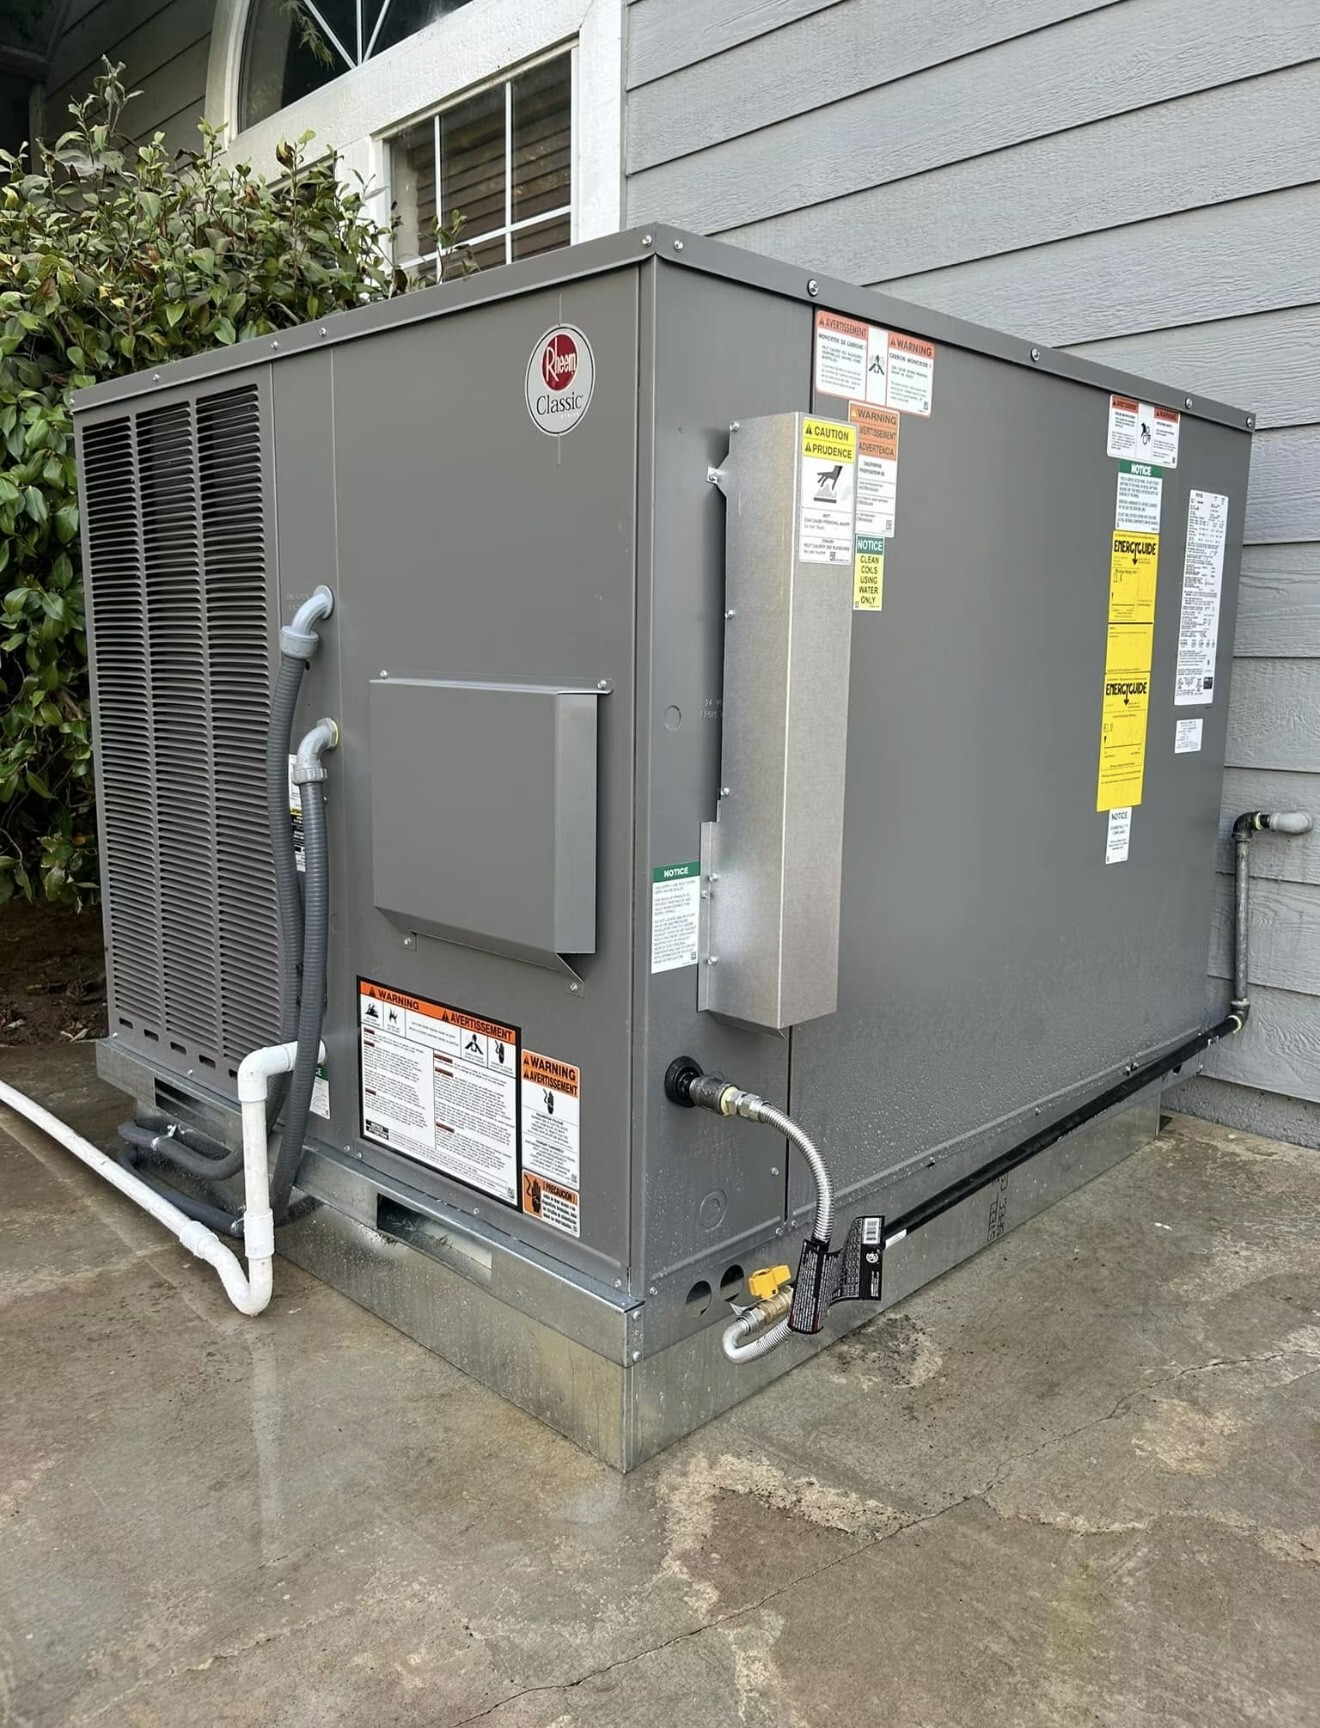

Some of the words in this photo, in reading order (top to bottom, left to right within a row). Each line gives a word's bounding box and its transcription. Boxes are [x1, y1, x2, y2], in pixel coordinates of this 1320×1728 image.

[826, 318, 867, 338] AVERTISSEMENT
[896, 339, 932, 357] WARNING
[546, 337, 577, 382] Rheem
[536, 391, 582, 416] Classic
[857, 409, 897, 425] WARNING
[814, 425, 849, 442] CAUTION
[812, 443, 852, 459] PRUDENCE
[858, 441, 895, 457] ADVERTENCIA
[1130, 463, 1152, 477] NOTICE
[857, 538, 883, 552] NOTICE
[1114, 540, 1156, 556] ENERGYGUIDE
[860, 555, 879, 565] CLEAN
[860, 565, 878, 575] COILS
[860, 575, 878, 585] USING
[859, 585, 879, 595] WATER
[860, 596, 876, 605] ONLY
[1105, 682, 1148, 696] ENERGYGUIDE
[1111, 811, 1128, 821] NOTICE
[663, 866, 689, 878] NOTICE
[378, 989, 419, 1011] WARNING
[450, 1012, 513, 1042] AVERTISSEMENT
[530, 1055, 576, 1082] WARNING
[529, 1070, 578, 1097] AVERTISSEMENT
